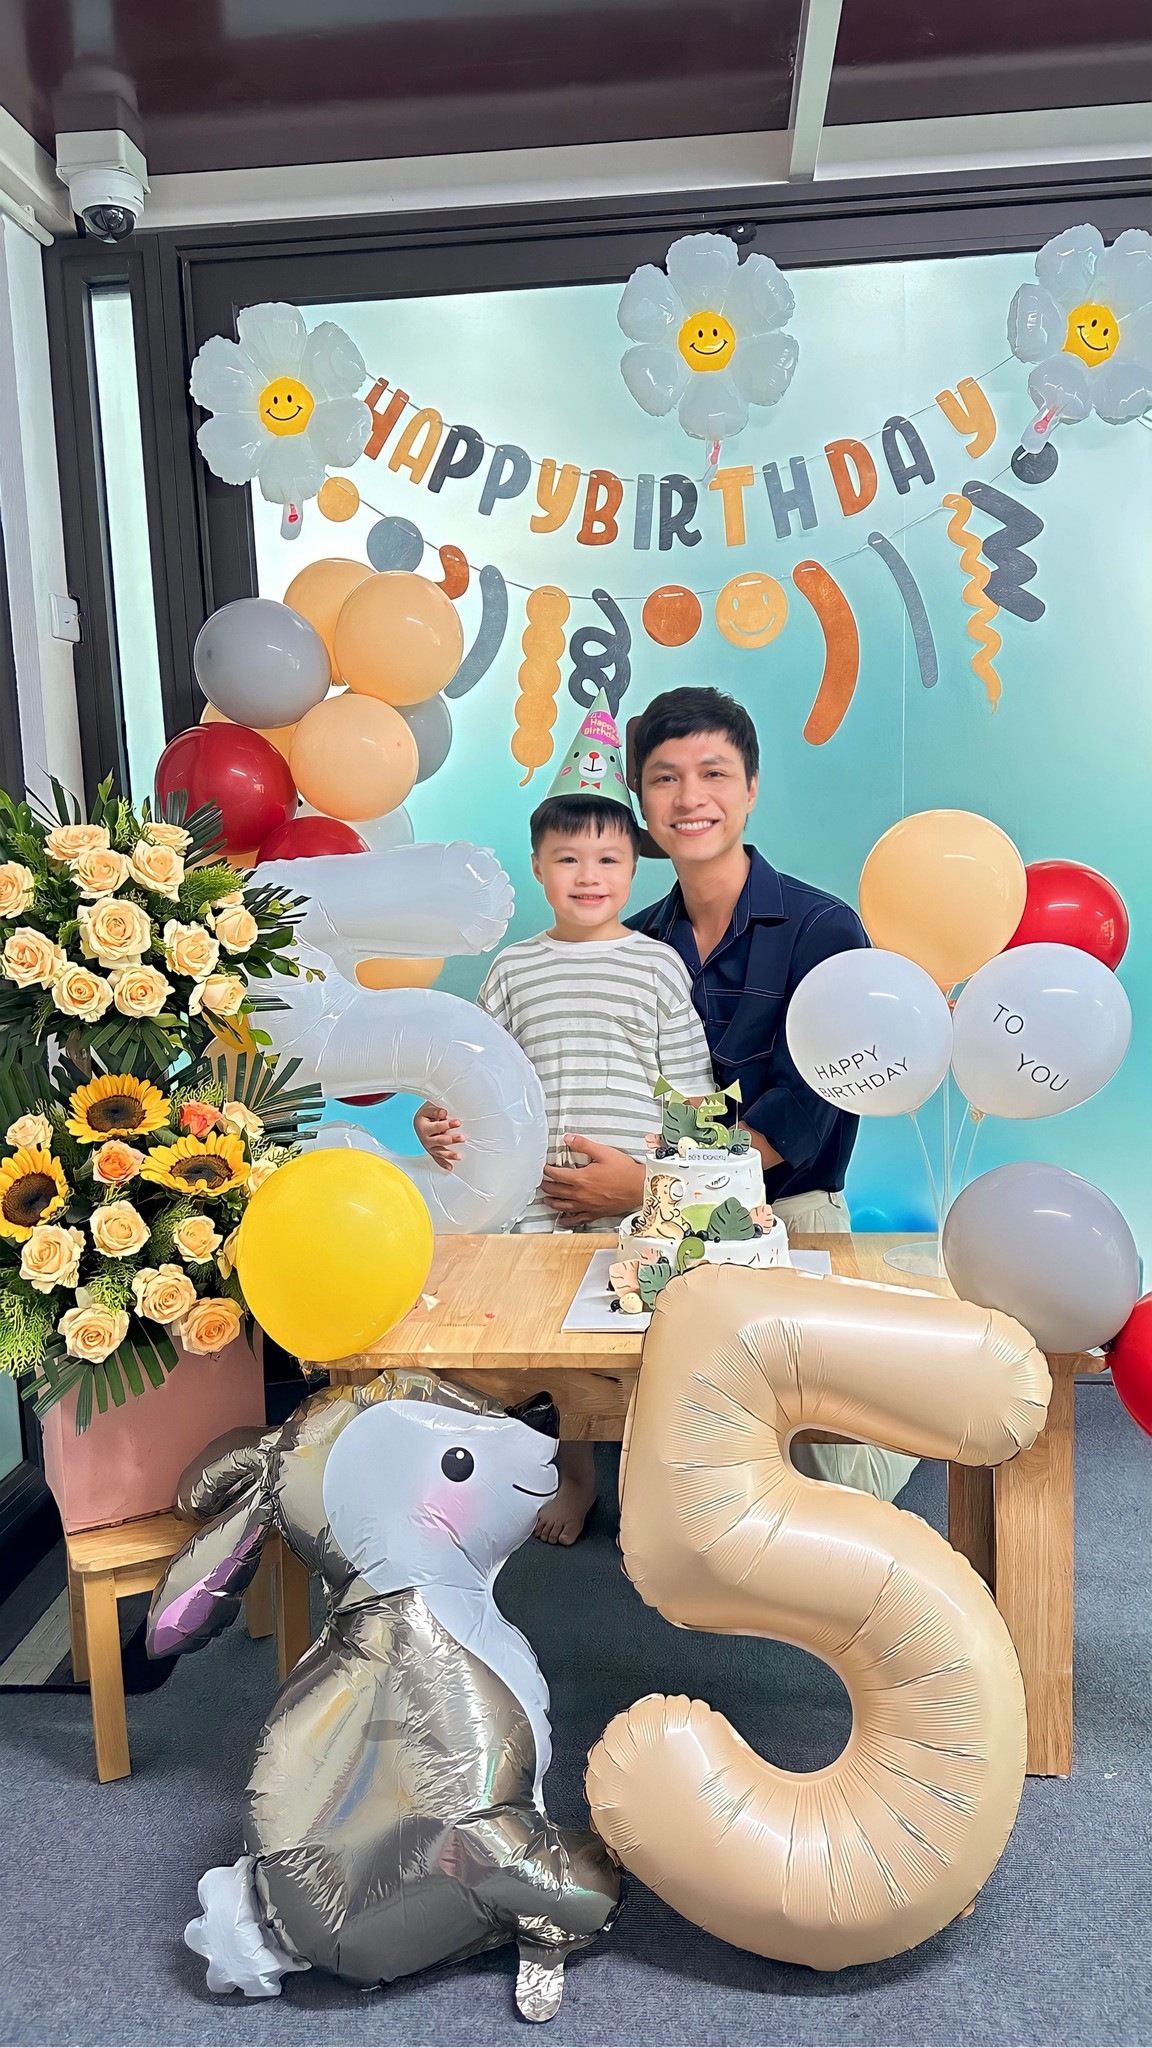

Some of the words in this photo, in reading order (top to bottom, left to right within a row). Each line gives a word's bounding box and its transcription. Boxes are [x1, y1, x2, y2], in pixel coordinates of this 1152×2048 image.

[992, 1003, 1025, 1035] TO
[814, 1044, 880, 1080] HAPPY
[818, 1056, 909, 1099] BIRTHDAY
[1016, 1052, 1070, 1092] YOU
[584, 1264, 1053, 1971] 5
